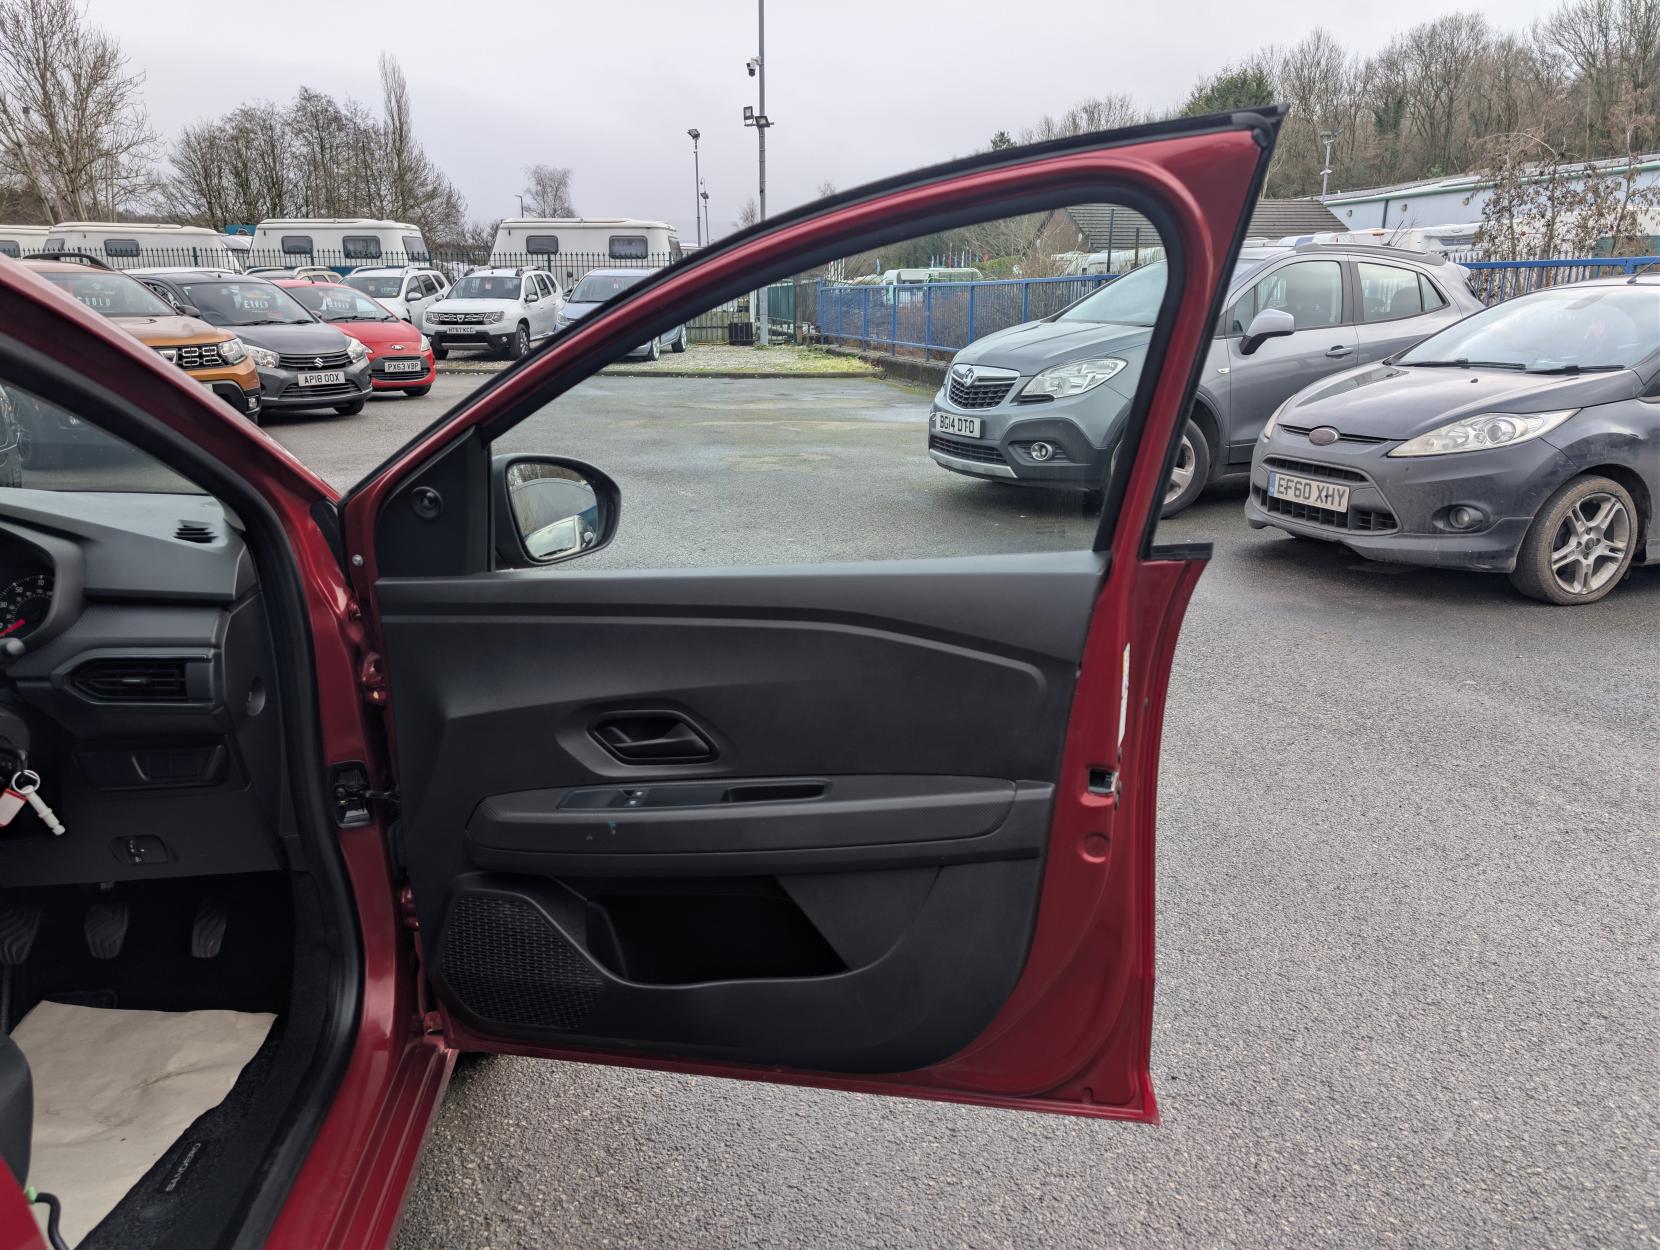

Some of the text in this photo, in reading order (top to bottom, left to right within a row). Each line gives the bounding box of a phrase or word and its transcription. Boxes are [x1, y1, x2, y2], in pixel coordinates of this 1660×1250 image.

[387, 363, 406, 371] PX63
[304, 374, 323, 385] AP18
[939, 415, 975, 434] BG14 DTO
[1277, 476, 1347, 508] EF60 XHY
